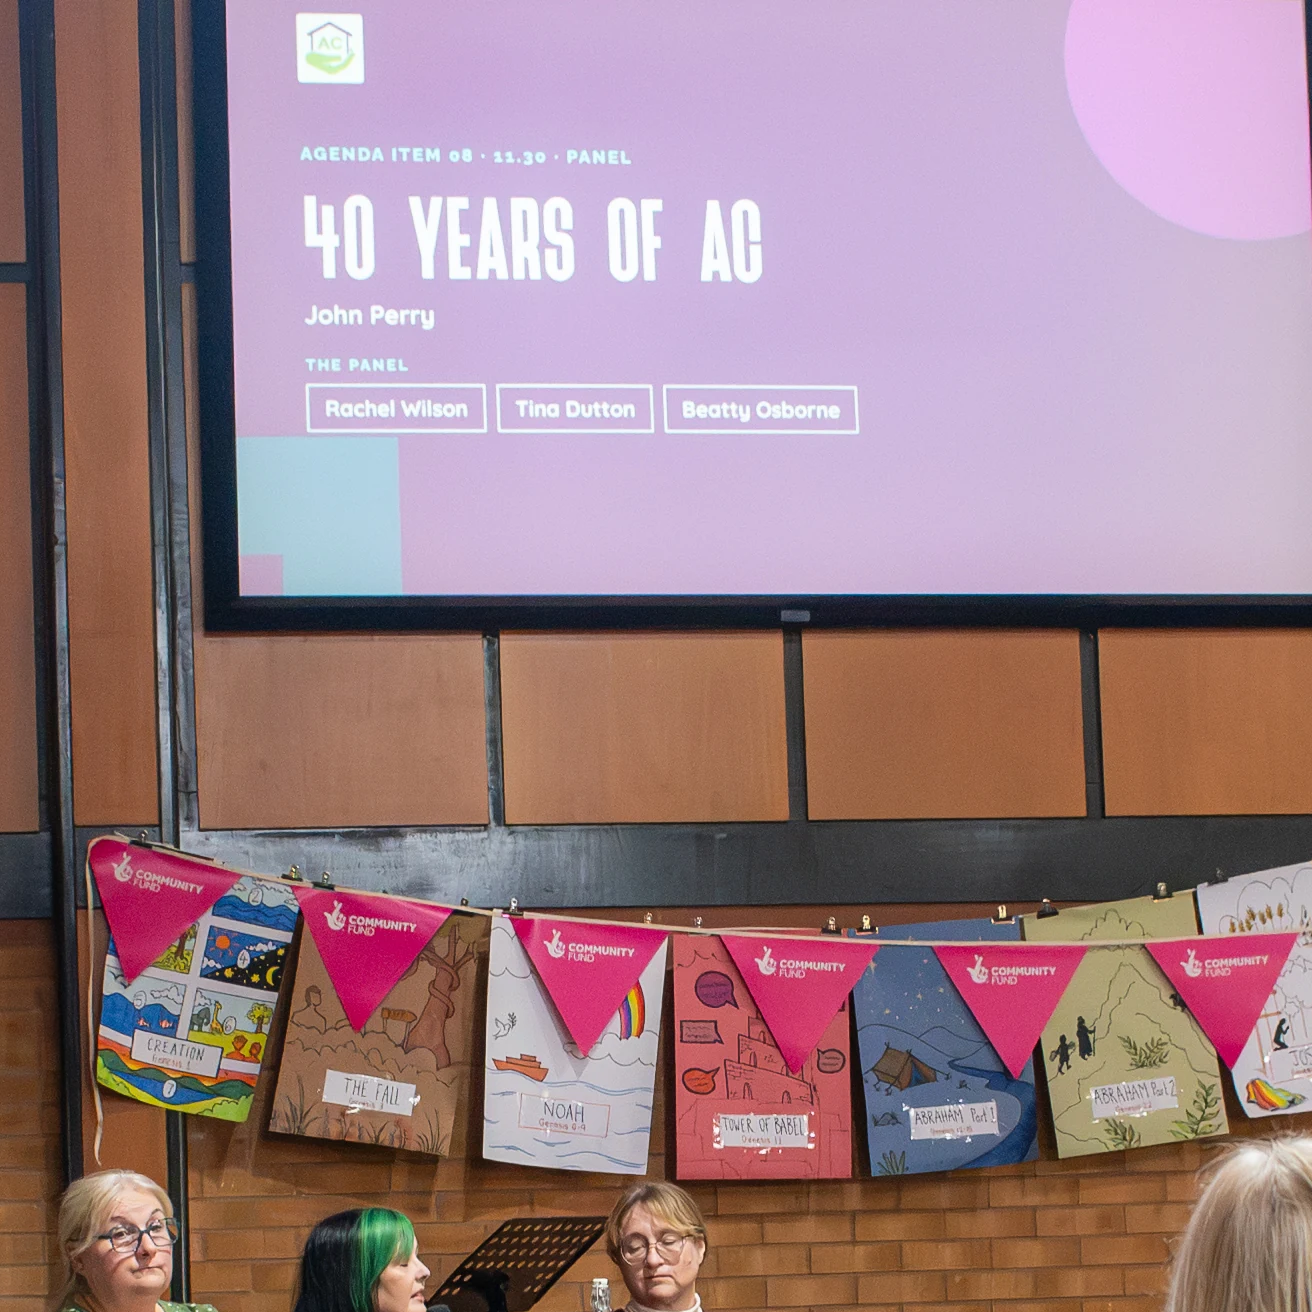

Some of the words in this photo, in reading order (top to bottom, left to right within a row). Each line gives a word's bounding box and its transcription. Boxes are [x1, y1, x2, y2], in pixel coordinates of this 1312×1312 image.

[318, 36, 343, 50] AC
[300, 146, 385, 162] AGENDA
[391, 147, 441, 162] ITEM
[449, 148, 473, 162] 08
[493, 151, 547, 165] 11.30
[566, 149, 632, 165] PANEL
[303, 194, 376, 281] 40
[408, 195, 576, 282] YEARS
[607, 196, 664, 283] OF
[700, 198, 763, 284] AC
[304, 303, 363, 326] John
[369, 304, 435, 331] Perry
[305, 357, 341, 372] THE
[348, 358, 409, 372] PANEL
[325, 399, 396, 418] Rachel
[401, 399, 468, 418] Wilson
[515, 399, 560, 418] Tina
[565, 399, 636, 419] Dutton
[682, 400, 751, 422] Beatty
[755, 400, 841, 420] Osborne
[132, 877, 162, 893] FUND
[135, 869, 204, 895] COMMUNITY
[347, 925, 376, 937] FUND
[348, 915, 417, 933] COMMUNITY
[567, 952, 595, 963] FUND
[568, 942, 635, 958] COMMUNITY
[779, 959, 846, 973] COMMUNITY
[1204, 954, 1269, 968] COMMUNITY
[778, 968, 806, 979] FUND
[991, 966, 1057, 976] COMMUNITY
[1204, 967, 1232, 978] FUND
[991, 976, 1018, 986] FUND
[147, 1036, 206, 1061] CREATION
[344, 1077, 369, 1098] THE
[375, 1083, 400, 1106] FALL
[1094, 1082, 1150, 1105] ABRAHAM
[1150, 1081, 1169, 1097] Part
[1168, 1079, 1177, 1097] 2
[543, 1101, 584, 1123] NOAH
[915, 1107, 964, 1125] ABRAHAM
[970, 1105, 988, 1123] Part
[721, 1117, 755, 1133] TOWER
[758, 1117, 771, 1133] OF
[773, 1117, 805, 1136] BABEL
